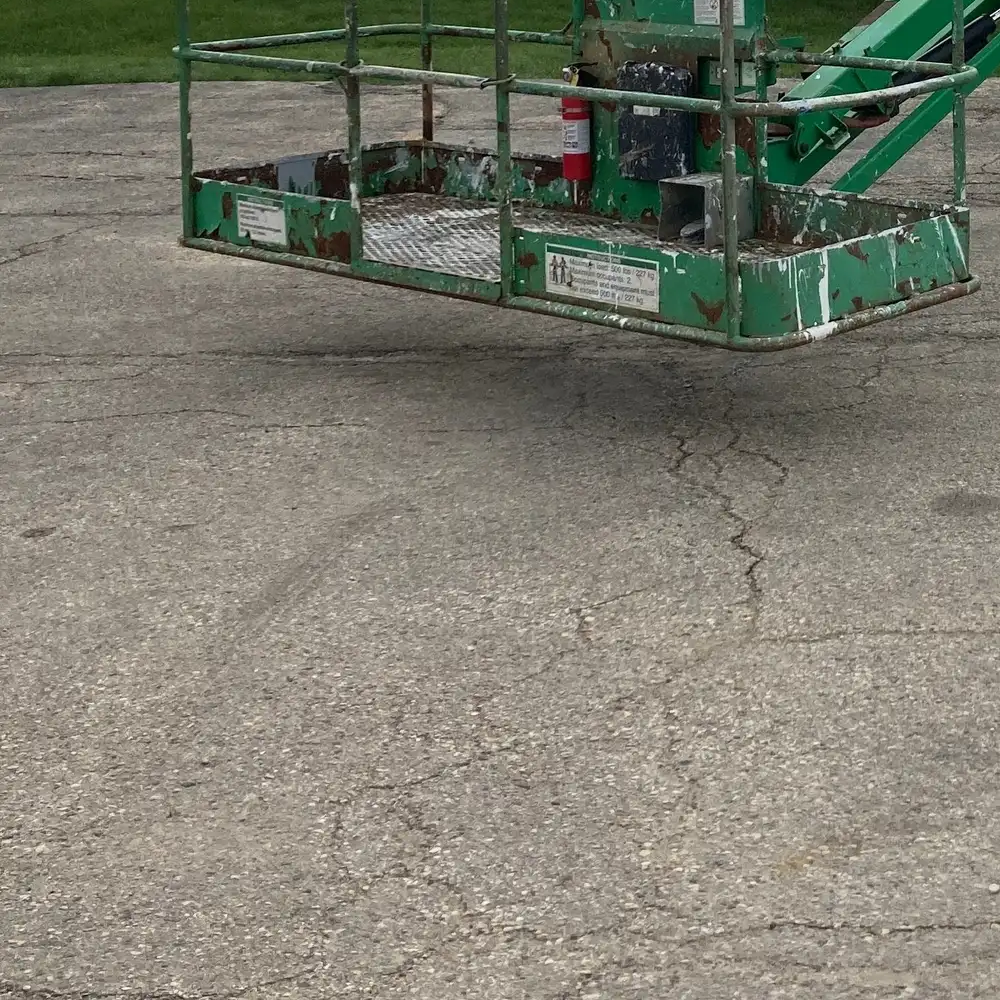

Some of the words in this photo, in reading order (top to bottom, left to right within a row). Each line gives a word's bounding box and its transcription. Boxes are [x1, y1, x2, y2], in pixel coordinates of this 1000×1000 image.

[611, 265, 621, 274] 500
[635, 269, 646, 278] 227
[624, 294, 635, 302] 227
